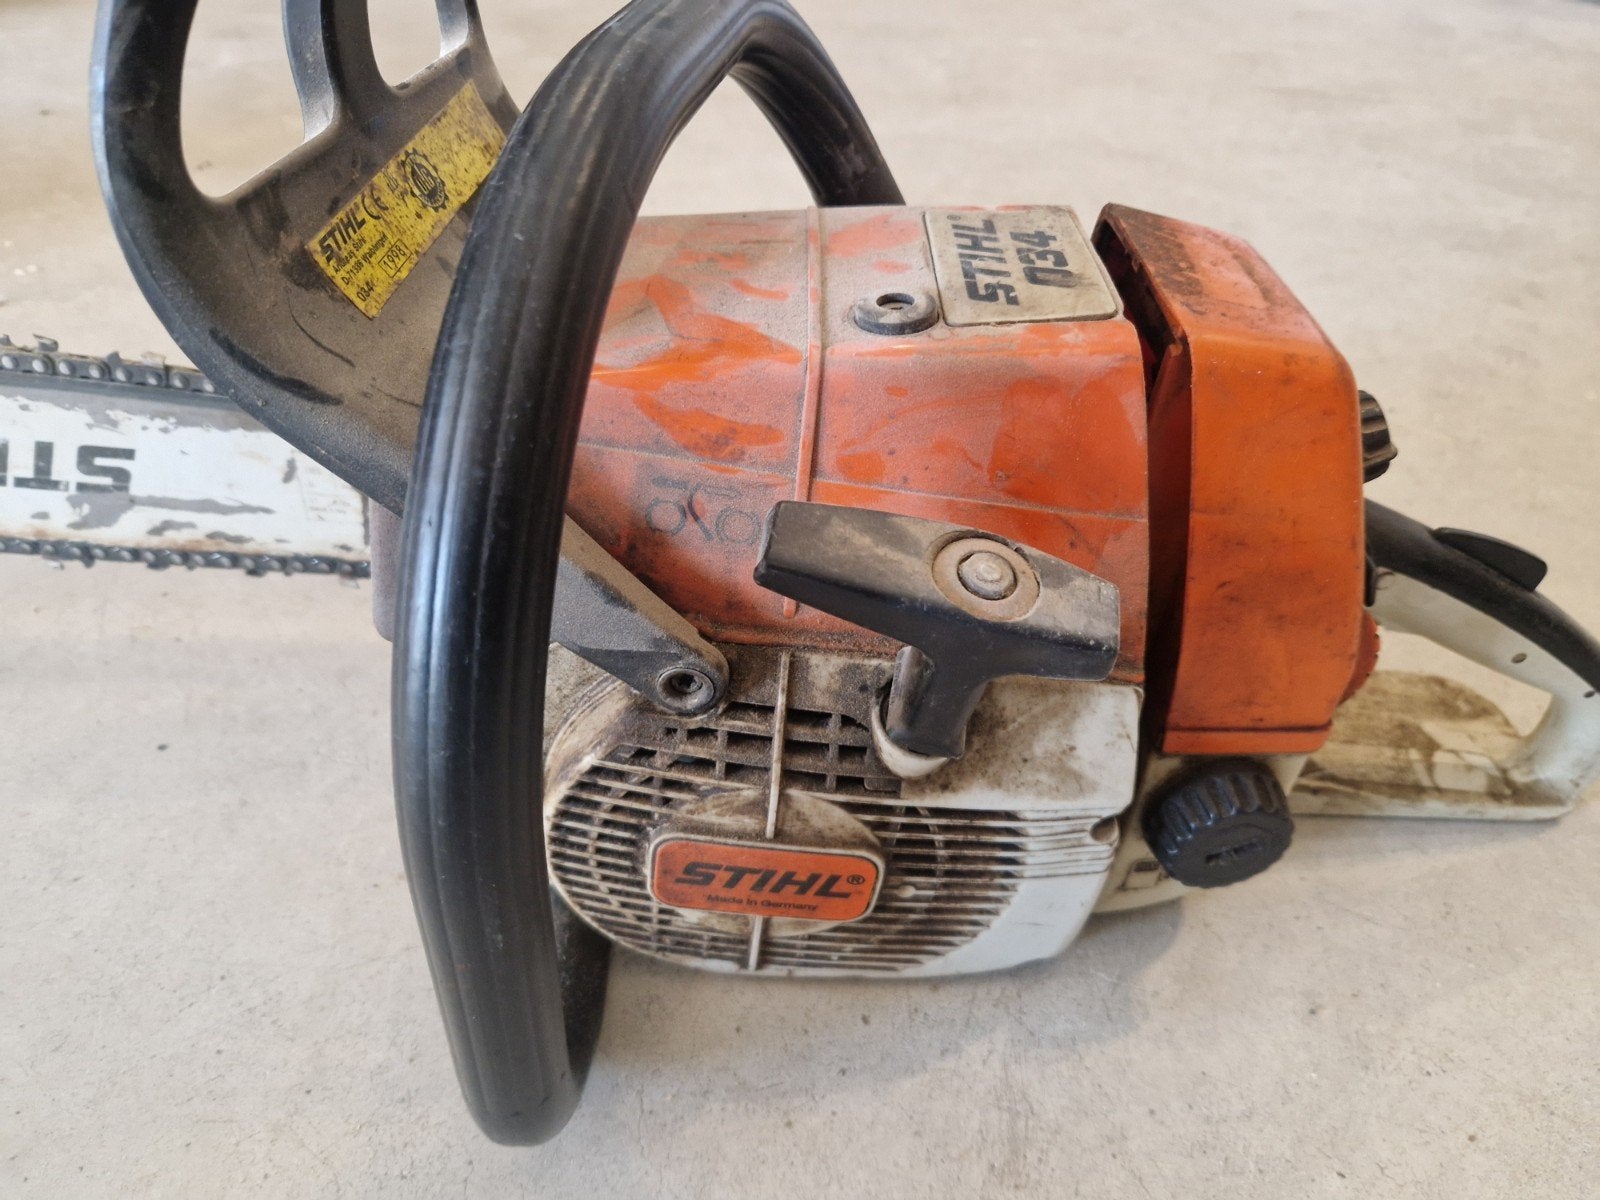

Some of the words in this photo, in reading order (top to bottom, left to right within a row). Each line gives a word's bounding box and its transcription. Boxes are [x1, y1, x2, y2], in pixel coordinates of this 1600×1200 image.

[382, 243, 406, 272] 1998
[1010, 229, 1079, 288] 034
[356, 280, 375, 302] 034
[706, 893, 744, 905] Made
[760, 899, 819, 912] Germany
